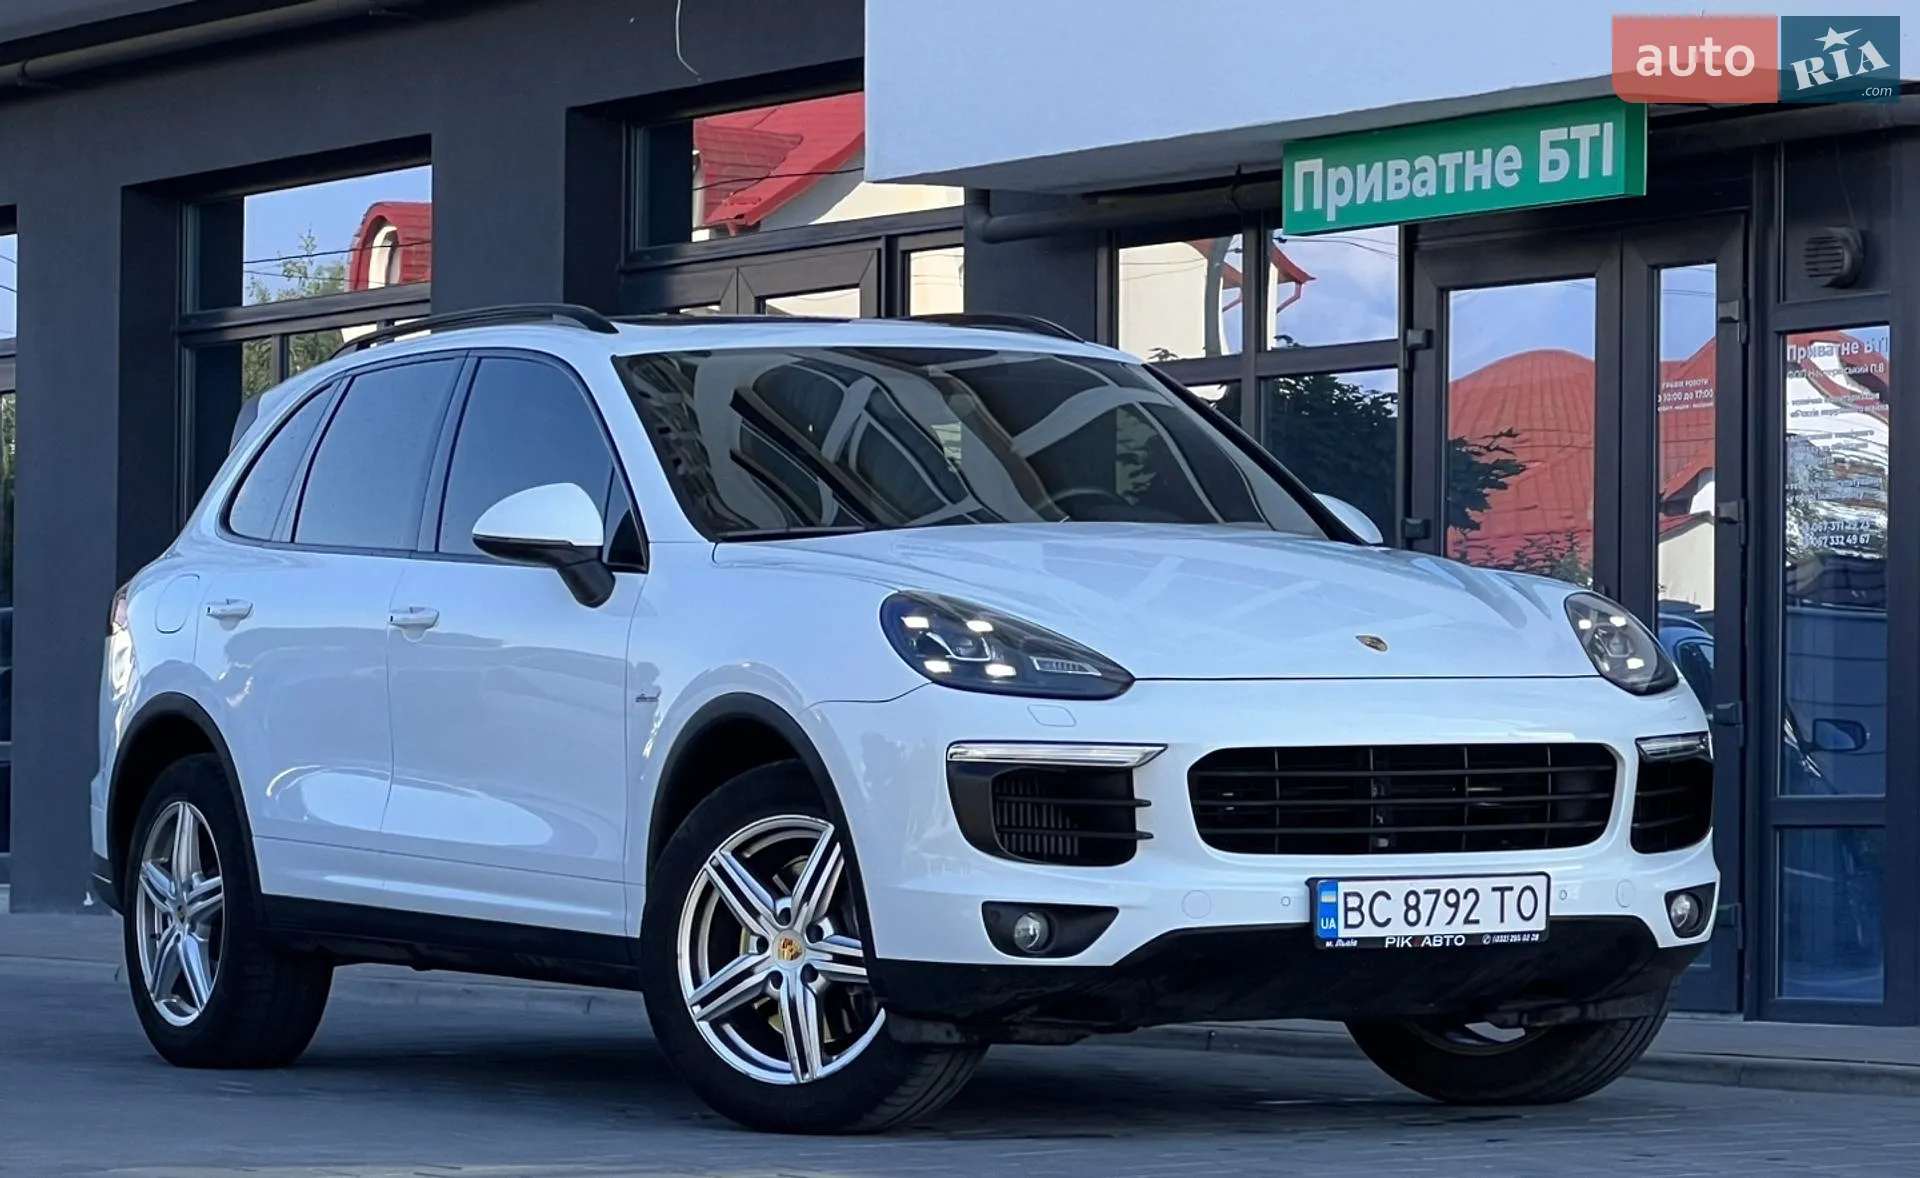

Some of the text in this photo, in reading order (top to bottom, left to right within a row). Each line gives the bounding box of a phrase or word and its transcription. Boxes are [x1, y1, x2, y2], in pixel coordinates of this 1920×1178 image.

[1293, 121, 1614, 222] Приватне БТІ
[1786, 341, 1860, 364] Приватне
[1320, 916, 1337, 931] UA
[1342, 884, 1539, 930] BC 8792 TO
